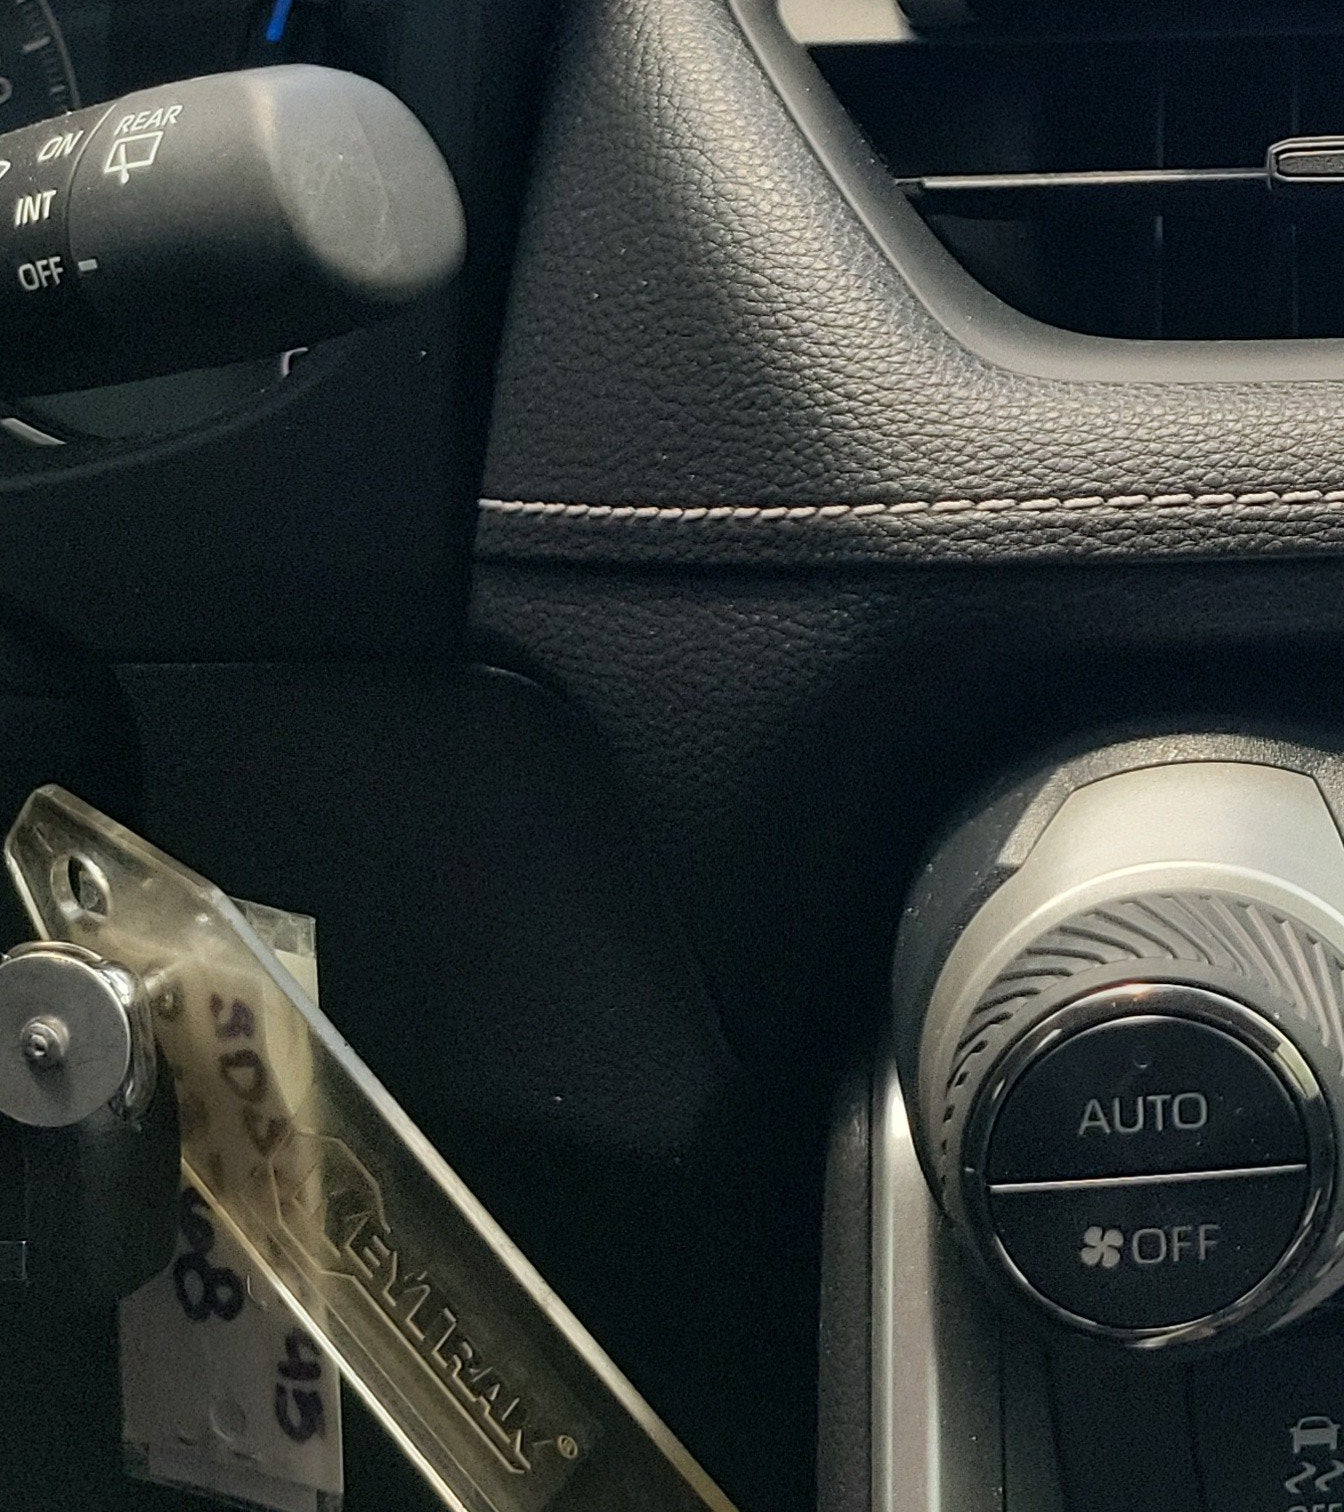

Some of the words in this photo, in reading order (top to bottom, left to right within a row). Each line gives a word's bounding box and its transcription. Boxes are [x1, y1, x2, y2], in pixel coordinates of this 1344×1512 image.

[114, 105, 184, 137] REAR
[37, 130, 84, 164] ON
[14, 189, 57, 228] INT
[18, 256, 64, 291] OFF
[1078, 1091, 1210, 1137] AUTO
[1131, 1224, 1219, 1265] OFF
